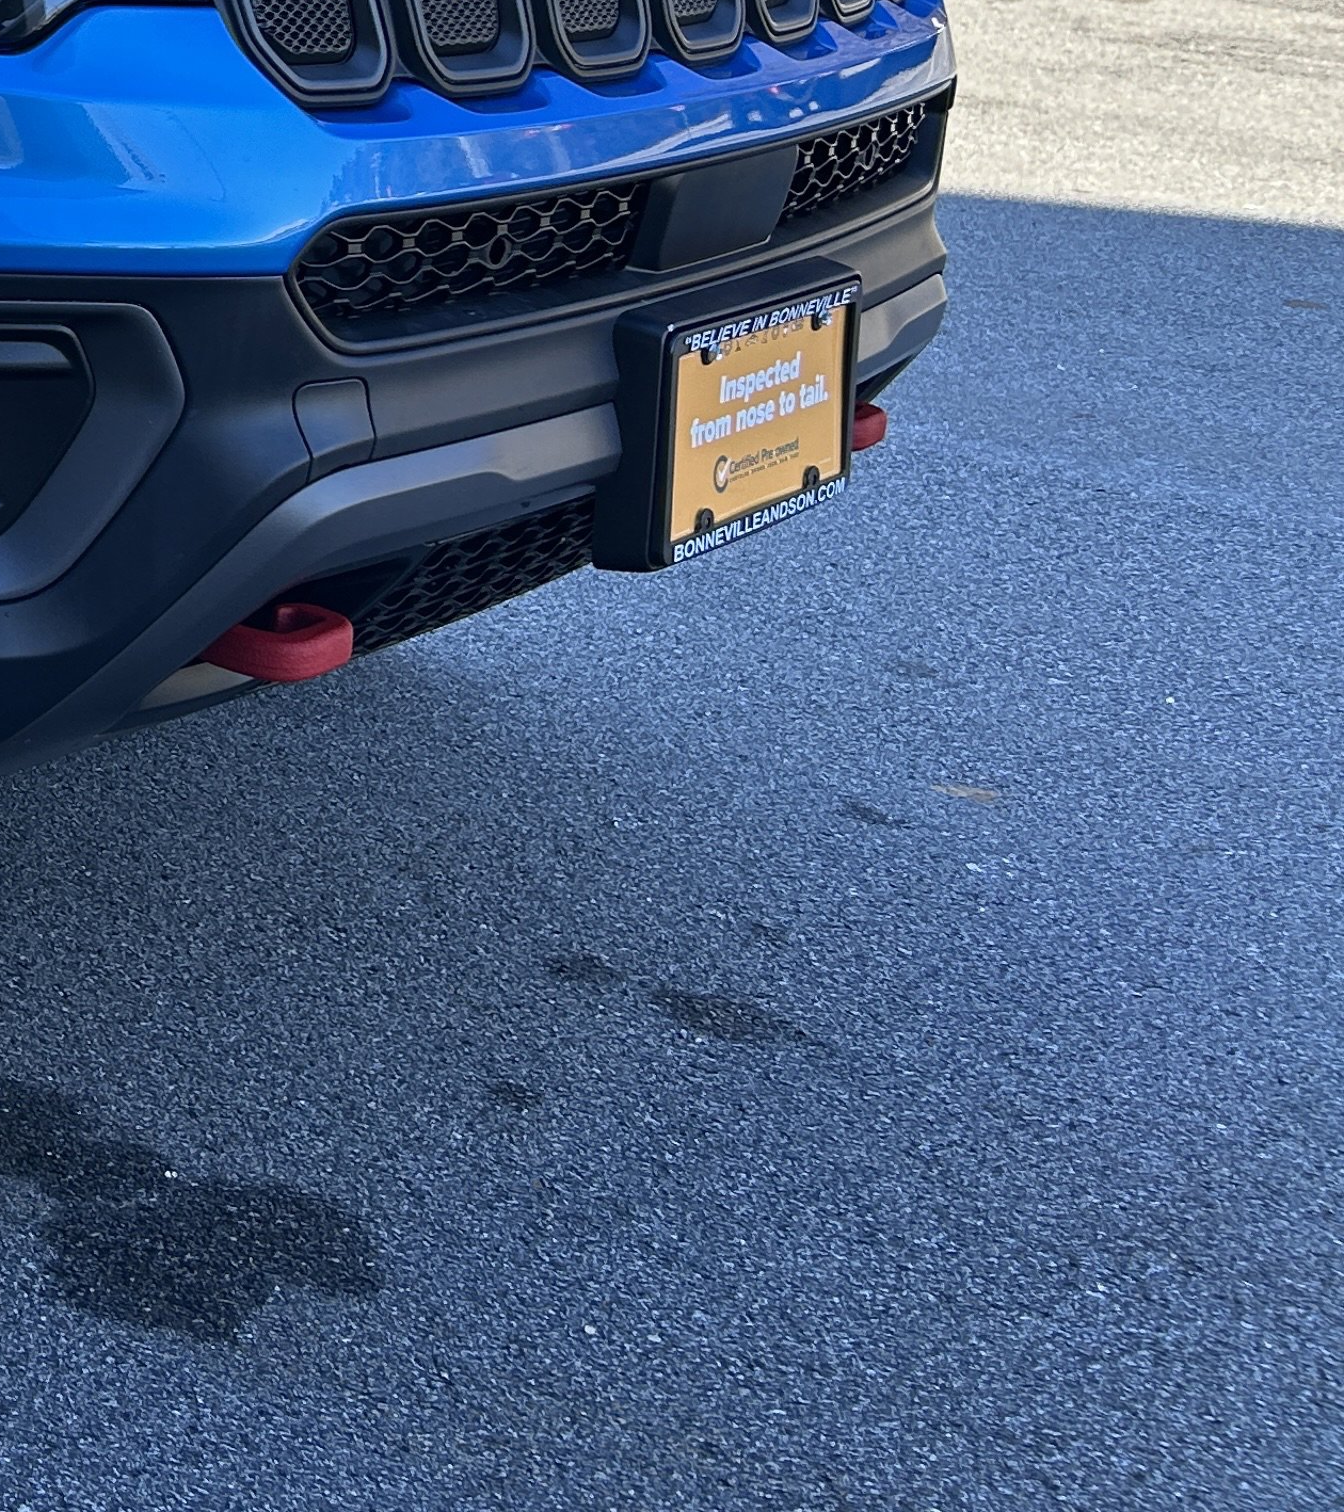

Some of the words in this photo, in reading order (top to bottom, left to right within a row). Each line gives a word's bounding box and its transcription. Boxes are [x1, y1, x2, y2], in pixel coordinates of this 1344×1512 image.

[753, 316, 767, 333] IN
[719, 351, 802, 404] Inspected
[690, 418, 732, 449] from
[735, 401, 776, 433] nose
[779, 391, 795, 417] to
[799, 374, 829, 410] tail.
[673, 477, 847, 563] BONNEVILLEANDSON.COM
